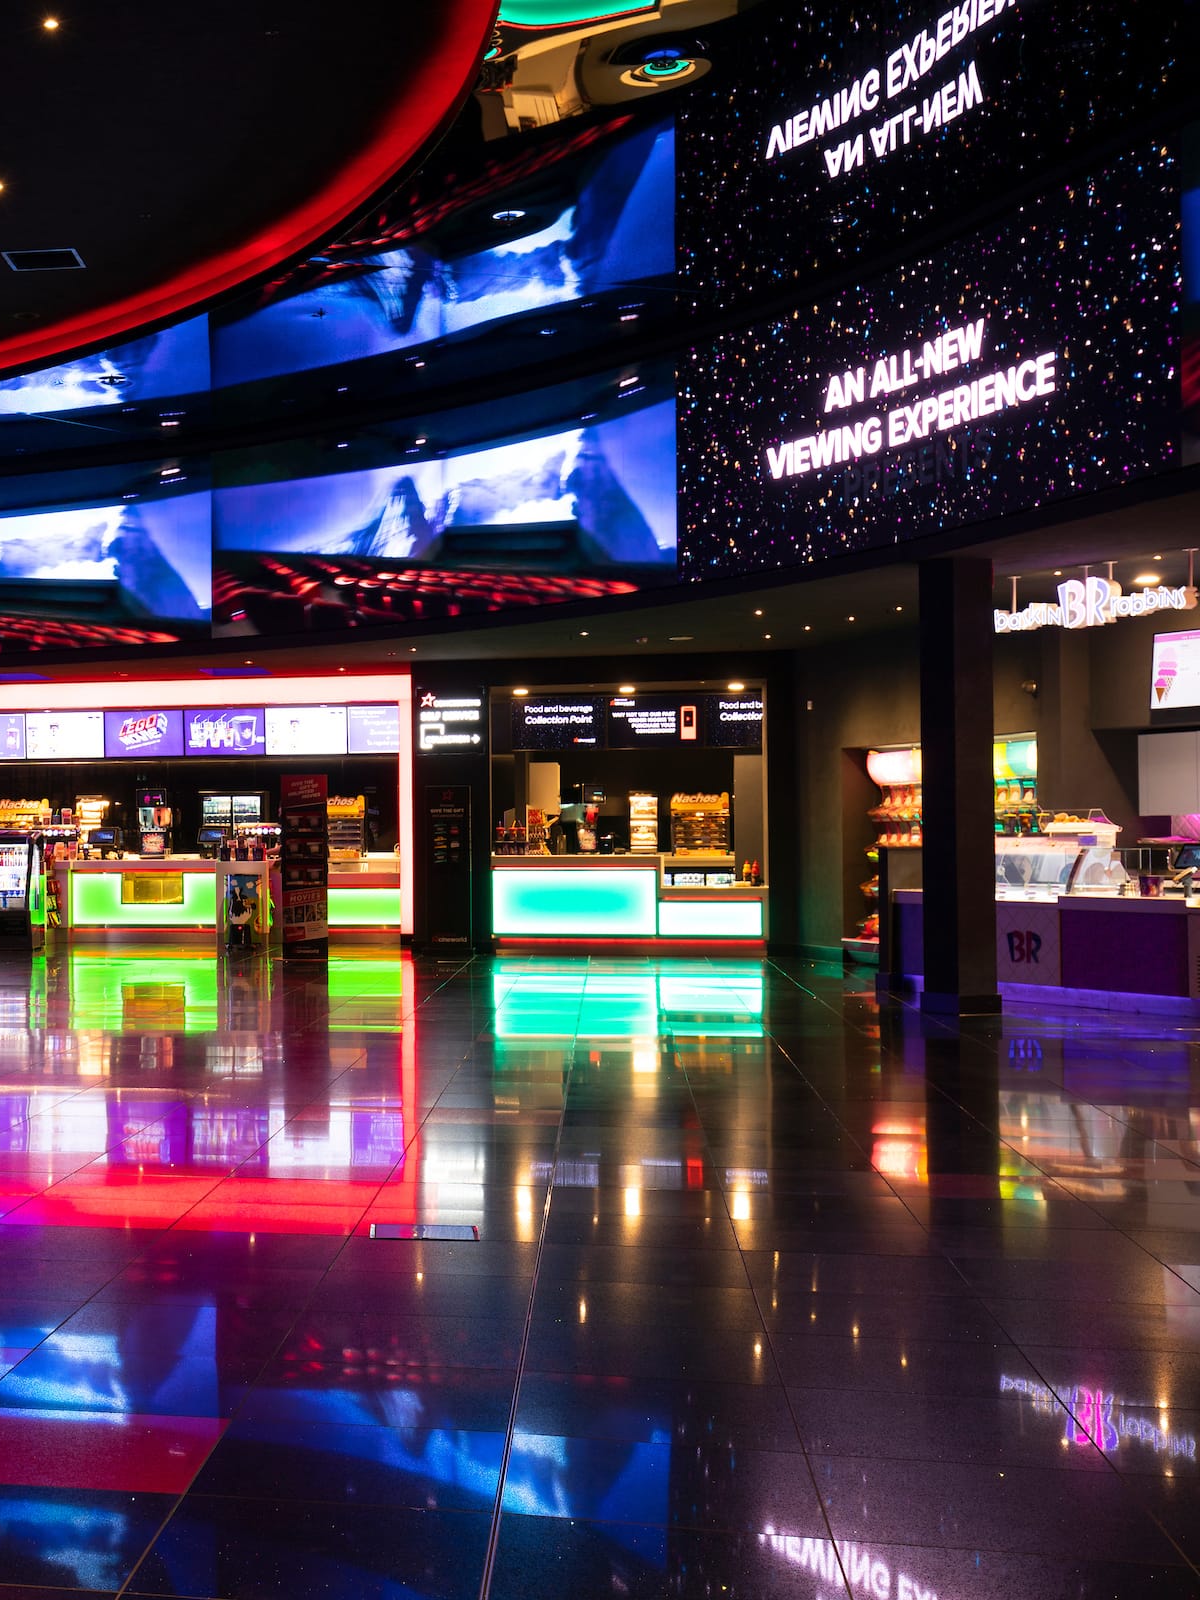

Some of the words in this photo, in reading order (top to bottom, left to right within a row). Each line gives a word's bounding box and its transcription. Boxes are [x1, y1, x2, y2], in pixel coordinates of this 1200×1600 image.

[824, 366, 865, 413] AN
[870, 318, 985, 398] ALL-NEW
[766, 416, 882, 480] VIEWING
[888, 351, 1056, 447] EXPERIENCE
[525, 705, 543, 713] Food
[559, 705, 593, 713] beverage
[719, 701, 739, 710] Food
[740, 701, 754, 709] and
[119, 713, 158, 737] LEGO
[525, 715, 569, 724] Collection
[570, 715, 593, 723] Point
[327, 795, 354, 806] chos
[672, 793, 718, 804] Nachos
[0, 799, 40, 810] Nachos
[290, 892, 321, 903] MOVIES
[1007, 930, 1042, 964] BR
